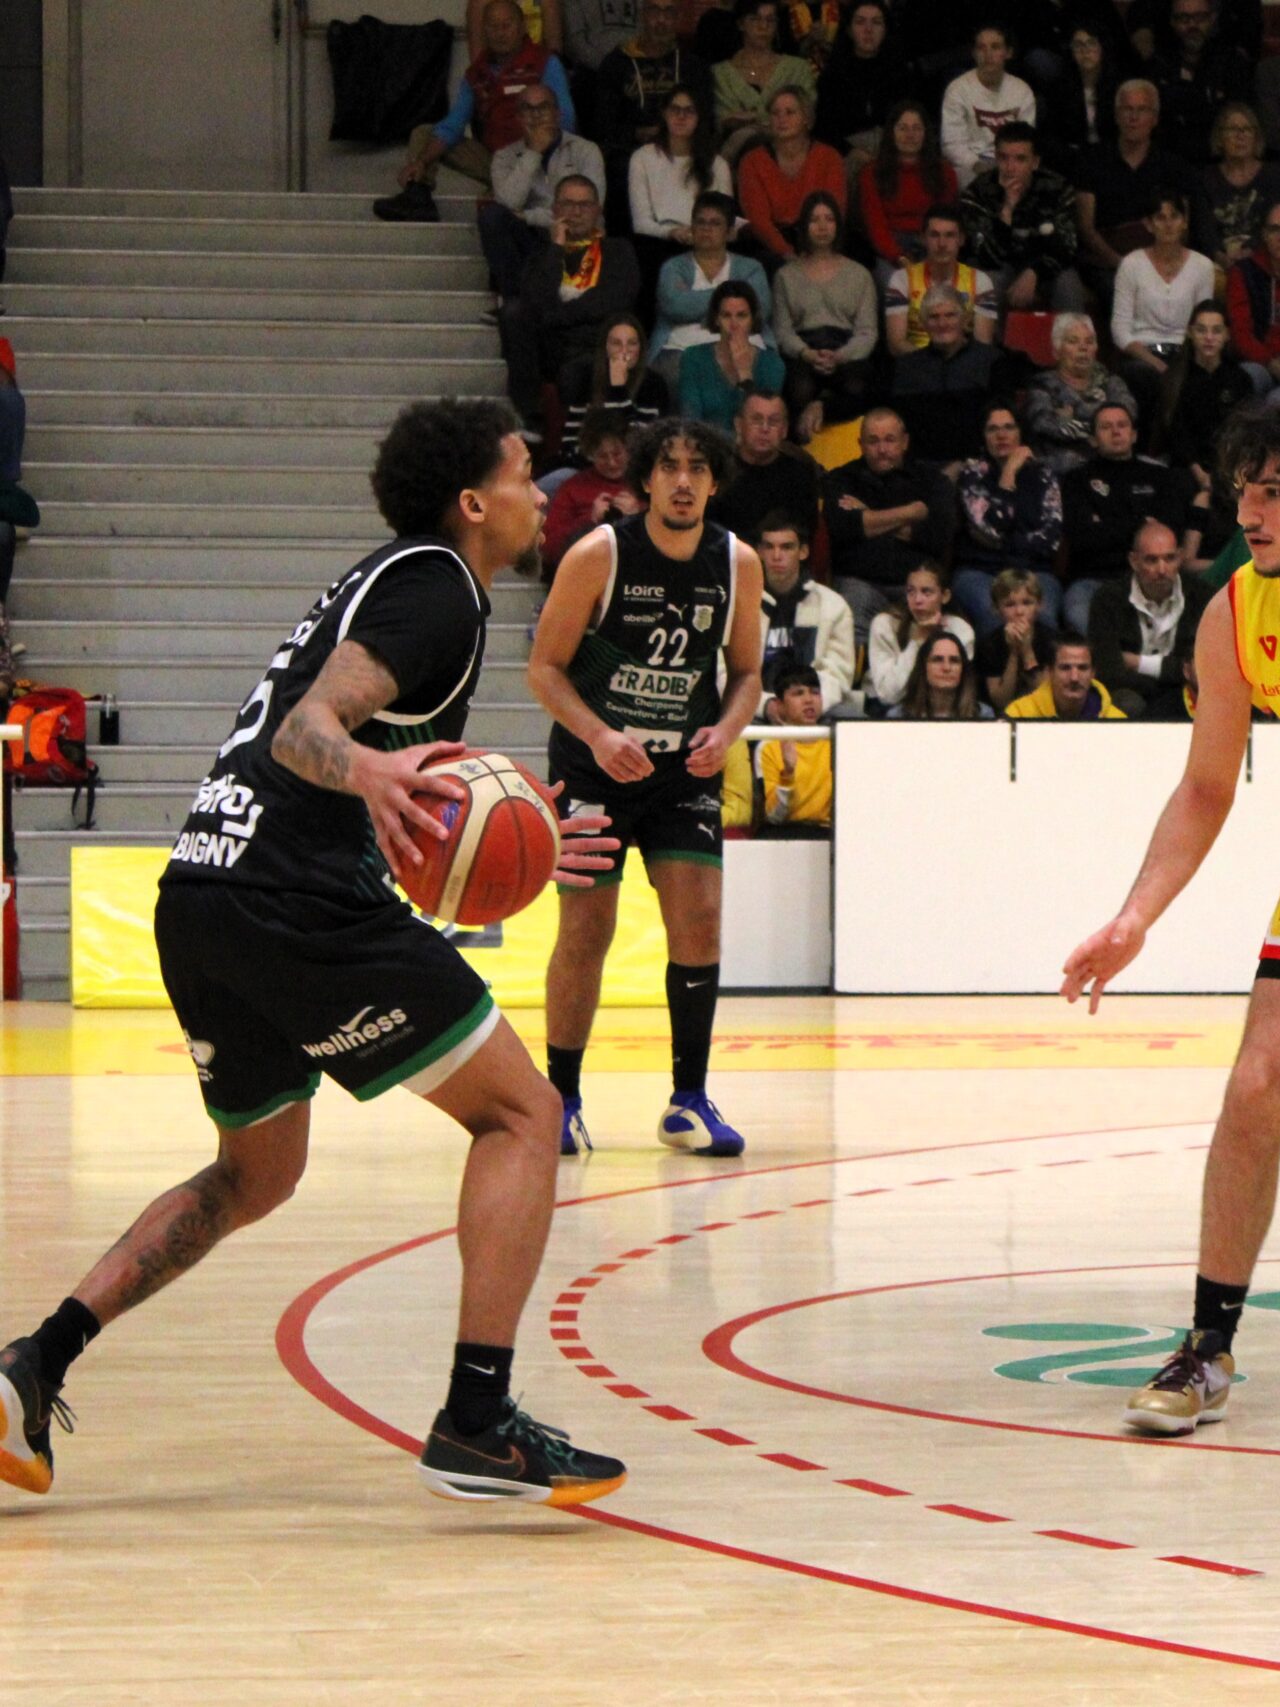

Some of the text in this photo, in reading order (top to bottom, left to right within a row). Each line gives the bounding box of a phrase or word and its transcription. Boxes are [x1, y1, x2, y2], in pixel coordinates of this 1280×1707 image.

[624, 584, 665, 597] Loire
[647, 627, 689, 667] 22
[302, 1008, 407, 1058] wellness
